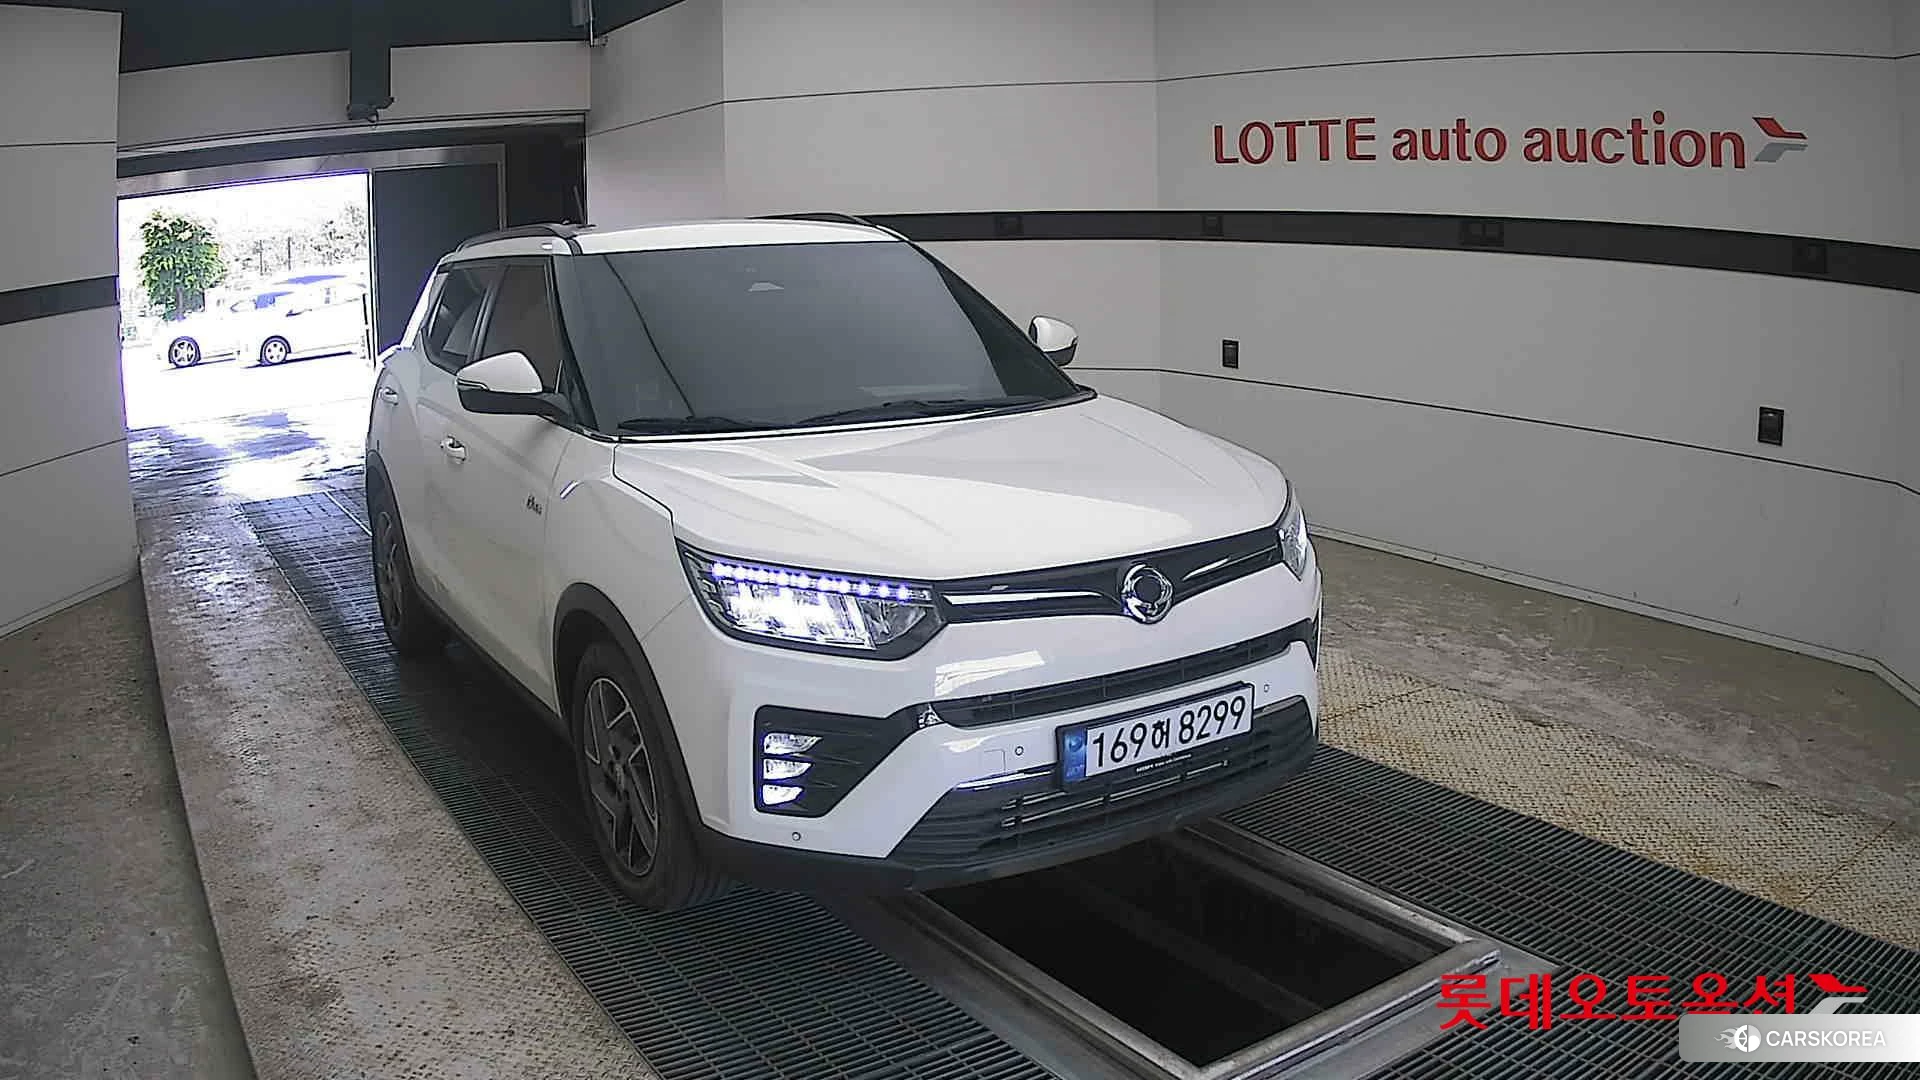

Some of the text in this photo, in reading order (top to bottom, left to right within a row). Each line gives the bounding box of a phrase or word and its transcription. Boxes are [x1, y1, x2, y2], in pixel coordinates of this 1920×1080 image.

[1214, 110, 1746, 168] LOTTE auto auction
[1092, 718, 1171, 767] 169허
[1178, 695, 1246, 744] 8299
